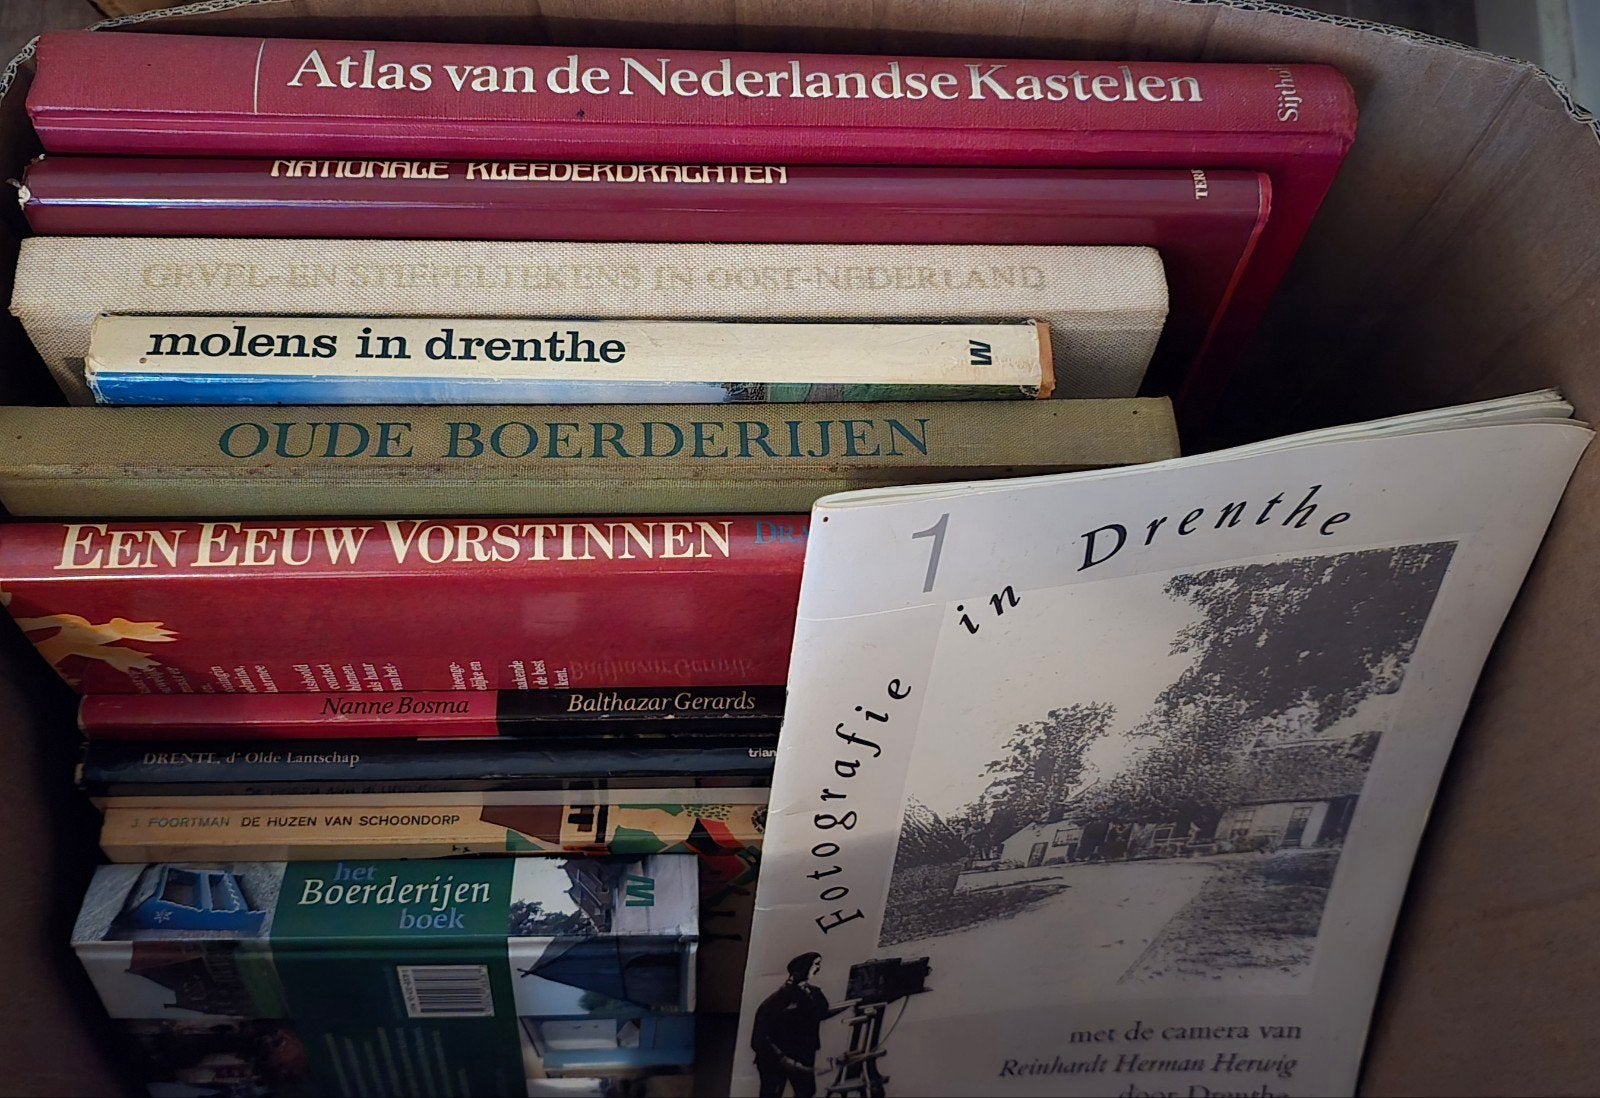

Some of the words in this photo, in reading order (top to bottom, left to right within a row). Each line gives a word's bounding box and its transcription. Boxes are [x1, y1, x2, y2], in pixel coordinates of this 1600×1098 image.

[287, 49, 433, 92] Atlas
[443, 63, 537, 93] van
[546, 54, 611, 95] de
[620, 57, 959, 100] Nederlandse
[965, 64, 1203, 102] Kastelen
[653, 265, 693, 291] IN
[146, 326, 337, 358] molens
[355, 328, 411, 359] in
[425, 328, 626, 363] drenthe
[218, 421, 413, 458] OUDE
[446, 418, 930, 458] BOERDERIJEN
[912, 513, 950, 593] 1
[321, 697, 394, 715] Nanne
[397, 697, 470, 715] Bosma
[567, 692, 673, 712] Balthazar
[674, 691, 756, 711] Gerards
[806, 678, 912, 934] Fotografie
[956, 584, 1021, 635] in
[1077, 484, 1352, 572] Drenthe
[245, 751, 281, 764] Olde
[287, 750, 360, 768] Lantschap
[241, 816, 260, 827] DE
[267, 815, 318, 827] HUZEN
[324, 815, 353, 827] VAN
[359, 814, 461, 827] SCHOONDORP
[334, 862, 378, 881] het
[298, 875, 491, 912] Boerderijen
[400, 906, 465, 930] boek
[1068, 1027, 1117, 1044] met
[1124, 1021, 1155, 1042] de
[1161, 1025, 1250, 1041] camera
[1259, 1025, 1302, 1040] van
[999, 1054, 1108, 1078] Reinhardt
[1113, 1054, 1206, 1074] Herman
[1210, 1053, 1299, 1078] Herwig
